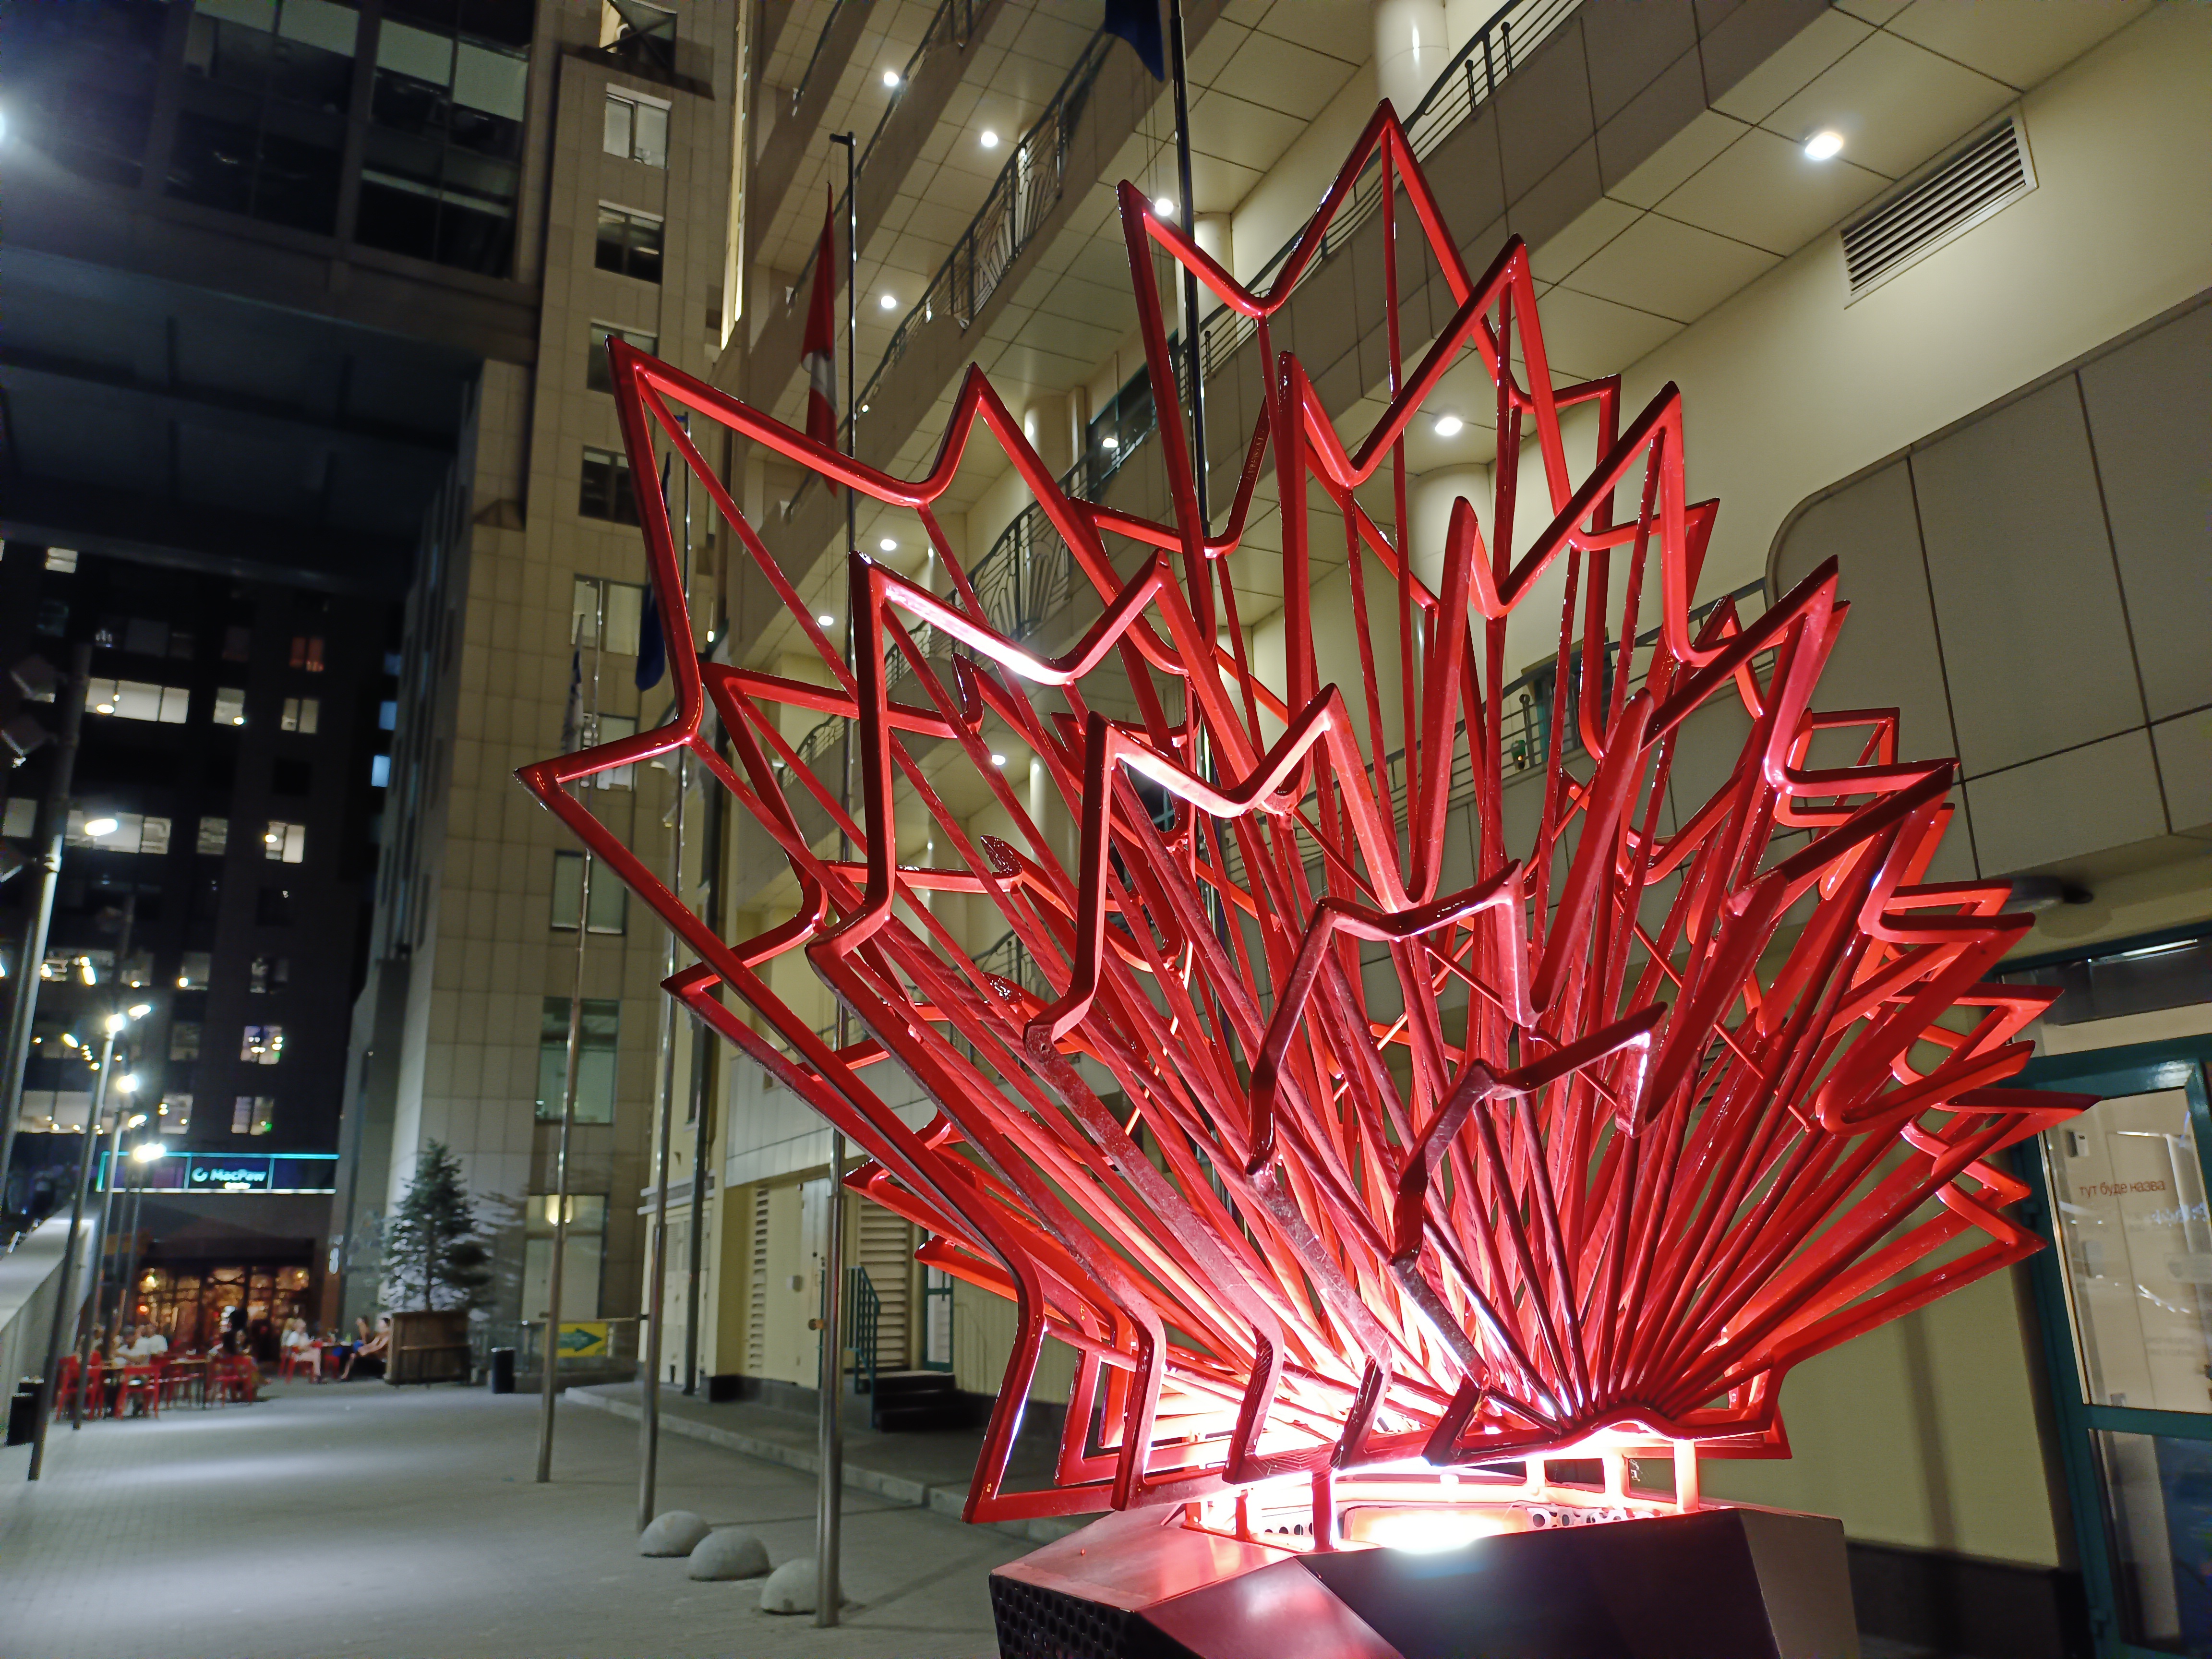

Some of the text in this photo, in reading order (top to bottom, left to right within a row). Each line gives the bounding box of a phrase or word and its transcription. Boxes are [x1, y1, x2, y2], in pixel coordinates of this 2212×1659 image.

[2079, 1180, 2166, 1198] тут буде назва
